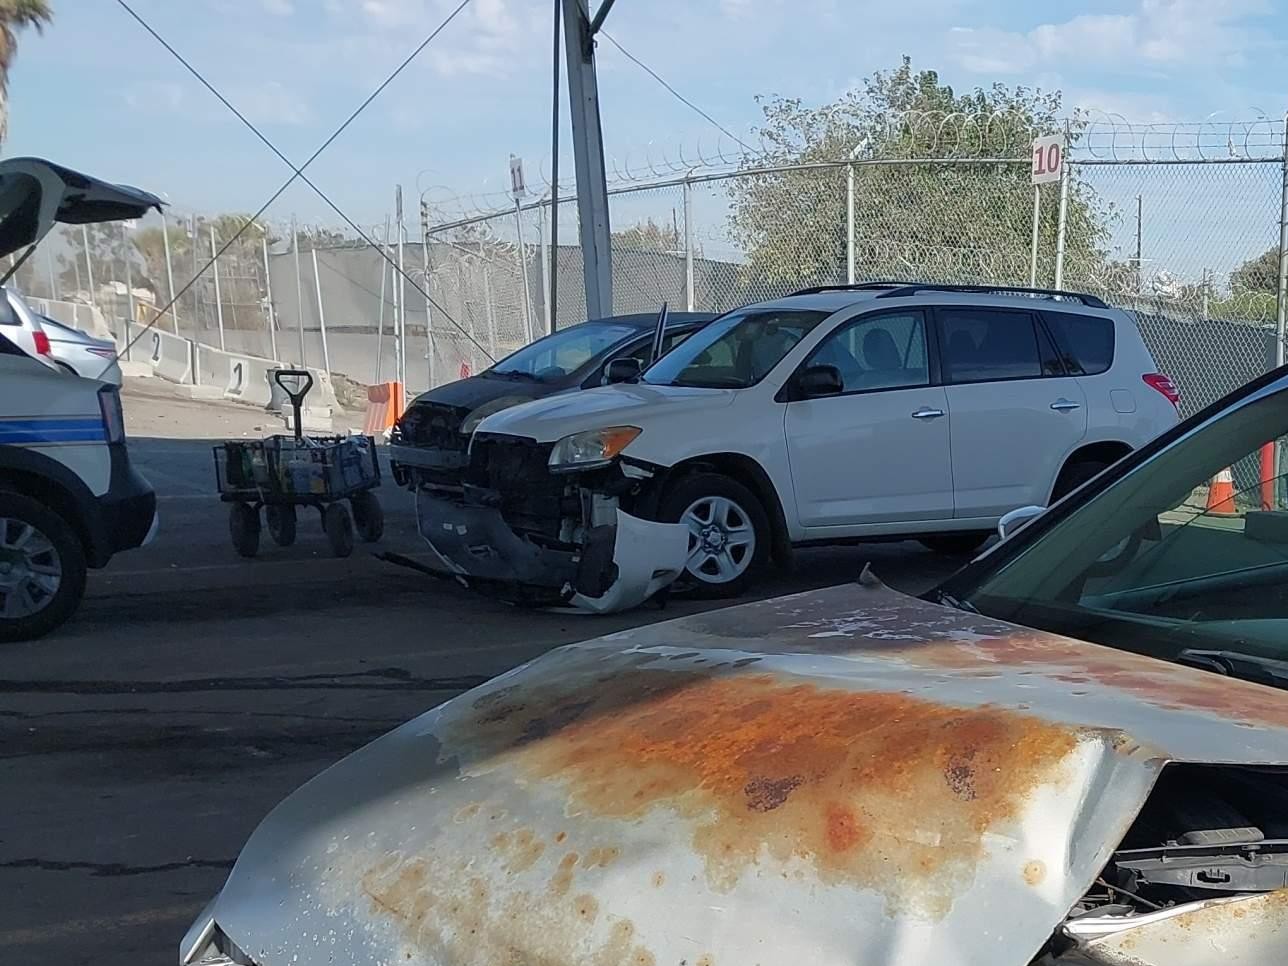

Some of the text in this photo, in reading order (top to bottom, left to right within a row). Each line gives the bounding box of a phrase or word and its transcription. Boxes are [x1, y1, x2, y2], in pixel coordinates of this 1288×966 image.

[1033, 143, 1060, 176] 10
[510, 165, 525, 193] 11
[151, 332, 161, 362] 2
[227, 362, 243, 395] 1
